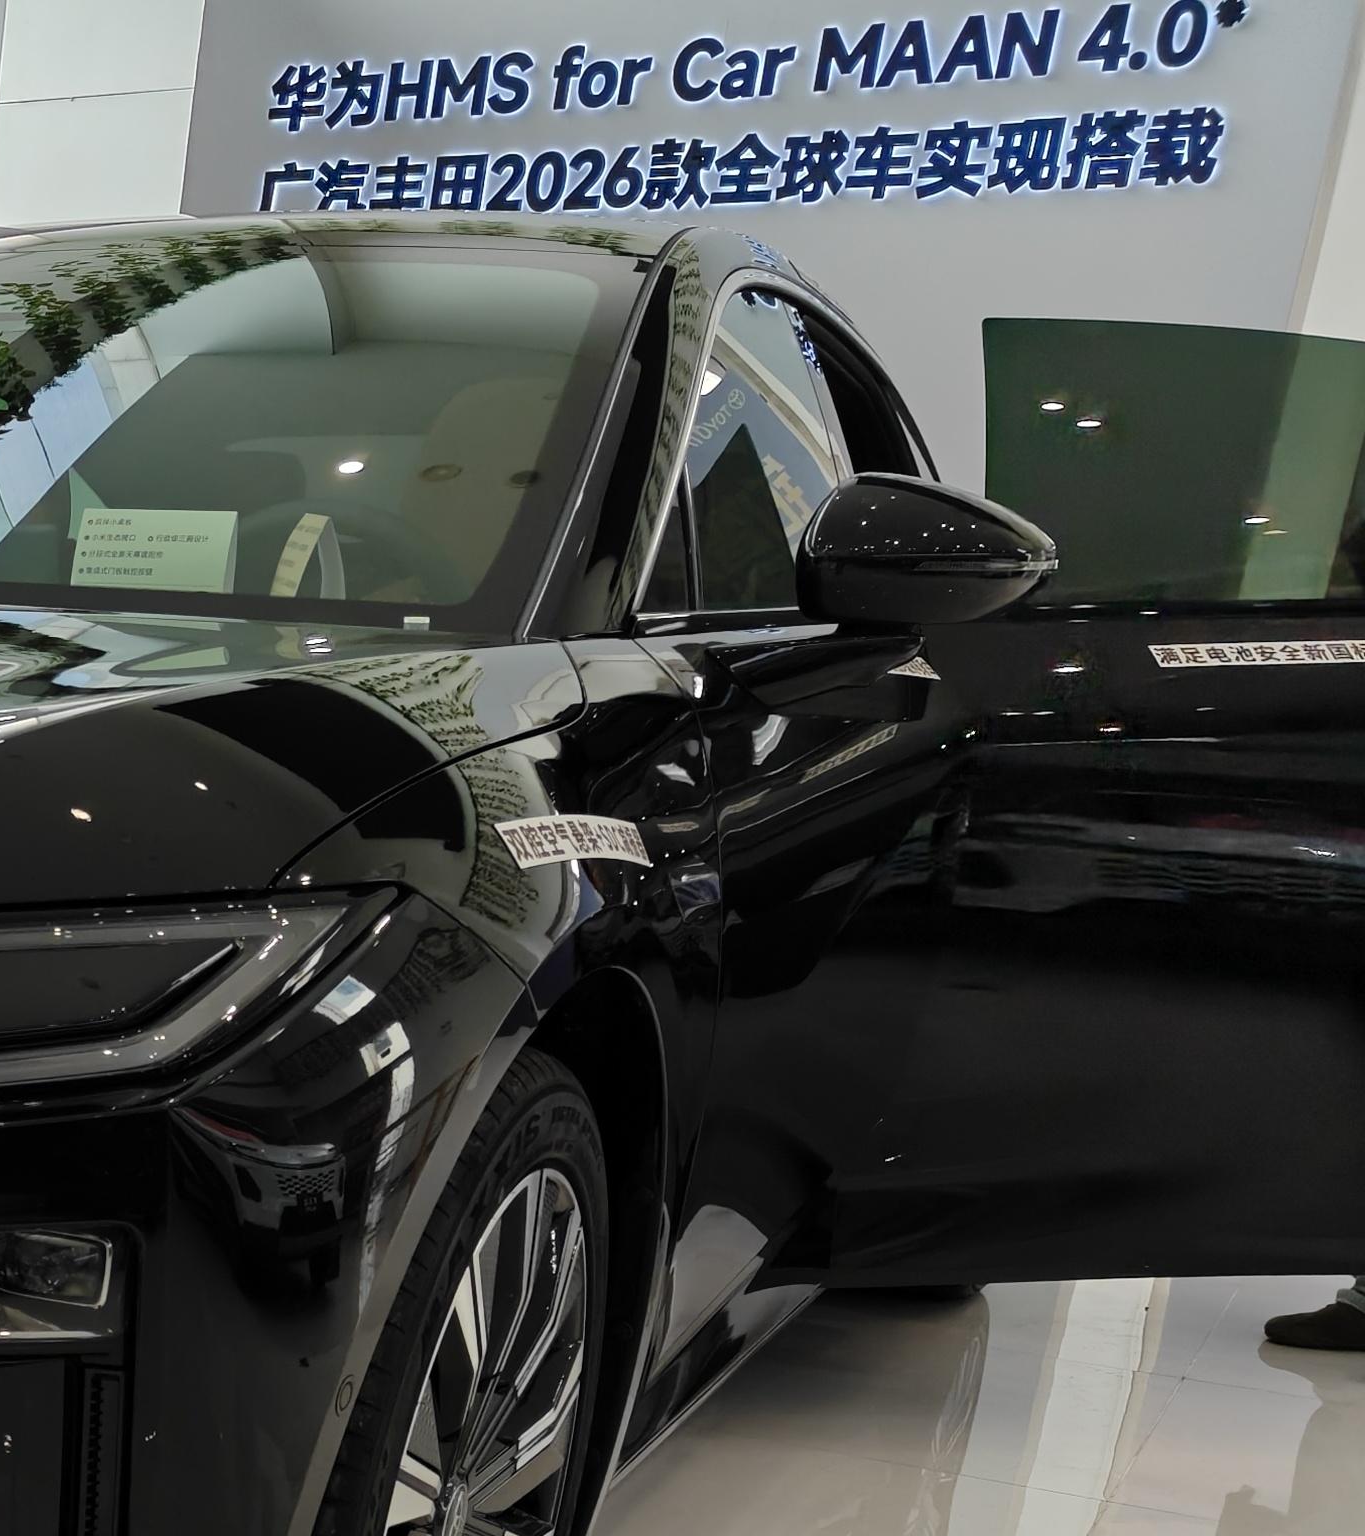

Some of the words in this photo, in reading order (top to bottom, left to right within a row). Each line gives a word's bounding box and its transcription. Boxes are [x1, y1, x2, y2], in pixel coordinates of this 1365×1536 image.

[268, 51, 534, 132] 华为HMS
[552, 45, 653, 111] for
[672, 37, 796, 102] Car
[813, 9, 1060, 92] MAAN
[259, 107, 1225, 213] 广汽丰田2026款全球车实现搭载
